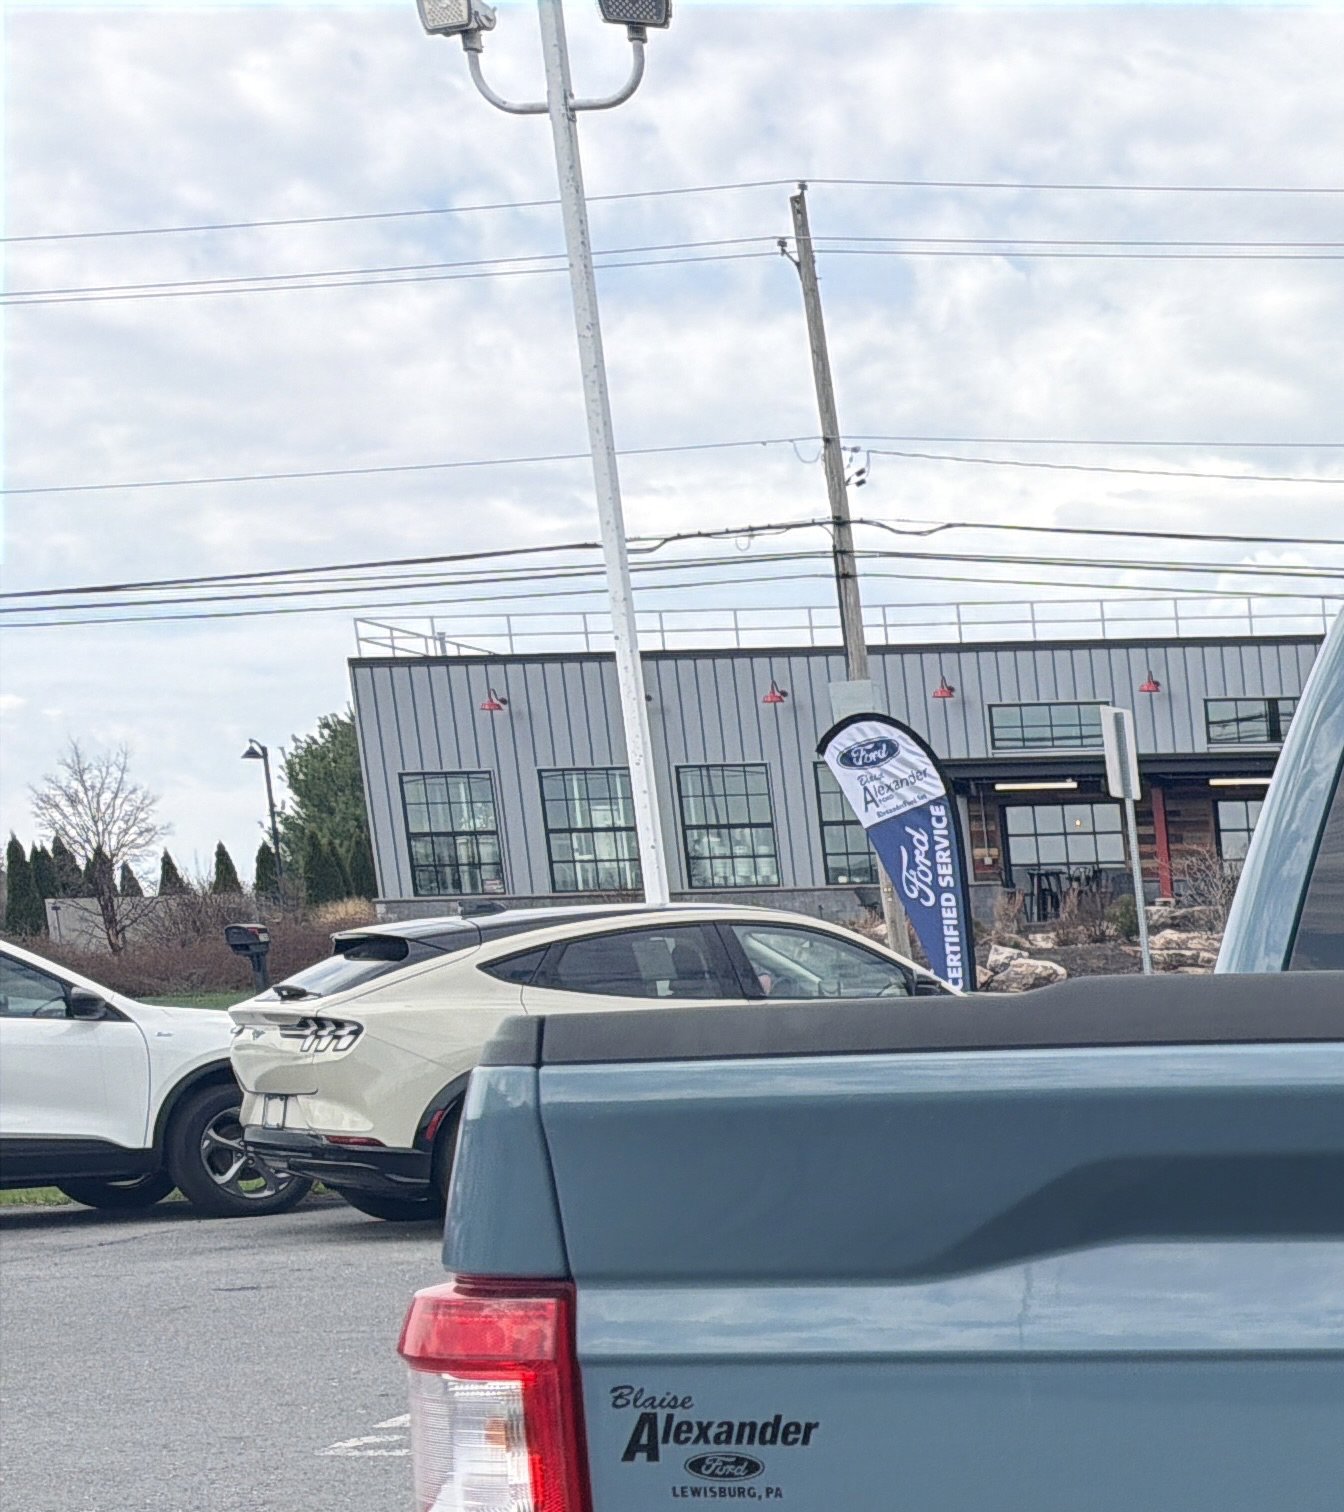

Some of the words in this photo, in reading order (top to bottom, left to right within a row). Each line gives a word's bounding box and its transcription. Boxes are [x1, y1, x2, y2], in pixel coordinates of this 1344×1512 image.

[851, 743, 889, 767] Ford
[863, 767, 928, 813] Alexander
[900, 826, 936, 907] Ford
[930, 804, 954, 888] SERVICE
[941, 892, 963, 989] CERTIFIED
[609, 1384, 695, 1410] Blaise
[621, 1411, 820, 1463] Alexander
[701, 1455, 749, 1477] Ford
[672, 1486, 763, 1500] LEWISBURG,
[765, 1486, 783, 1499] PA
